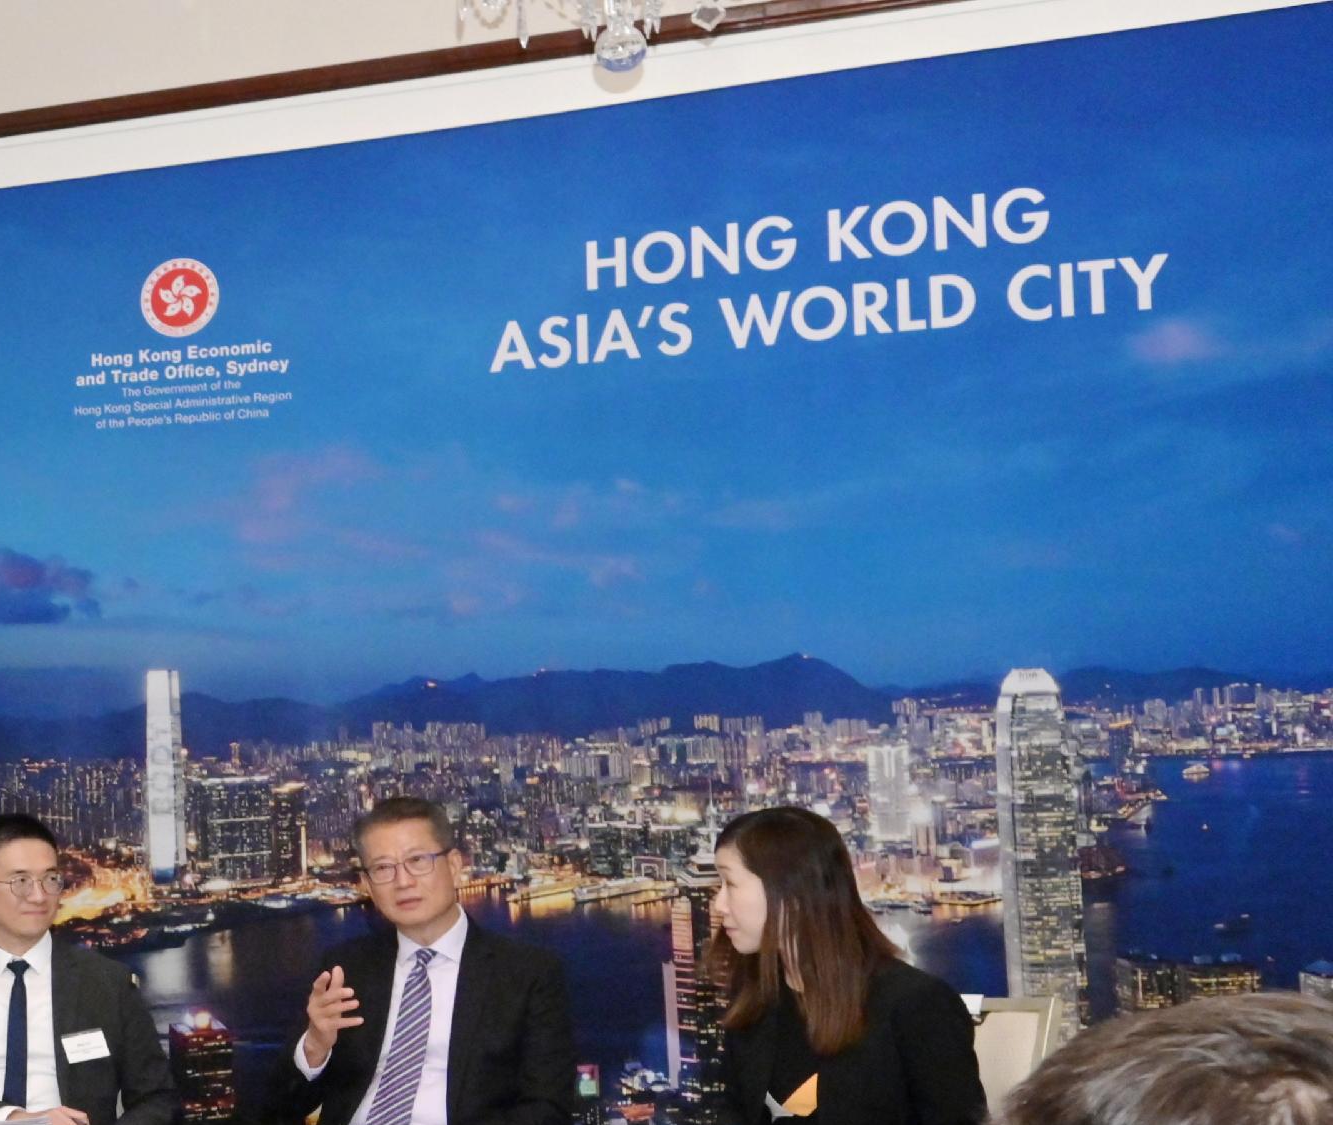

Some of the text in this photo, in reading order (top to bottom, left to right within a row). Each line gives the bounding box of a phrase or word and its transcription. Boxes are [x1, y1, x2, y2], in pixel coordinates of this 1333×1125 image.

[585, 187, 1050, 291] HONG KONG
[490, 253, 1169, 373] ASIA'S WORLD CITY
[91, 339, 272, 368] Hong Kong Economic
[76, 357, 290, 387] and Trade Office, Sydney
[122, 380, 242, 398] The Government of the
[74, 391, 293, 417] Hong Kong Special Administrative Region
[96, 406, 270, 430] of the People's Republic of China
